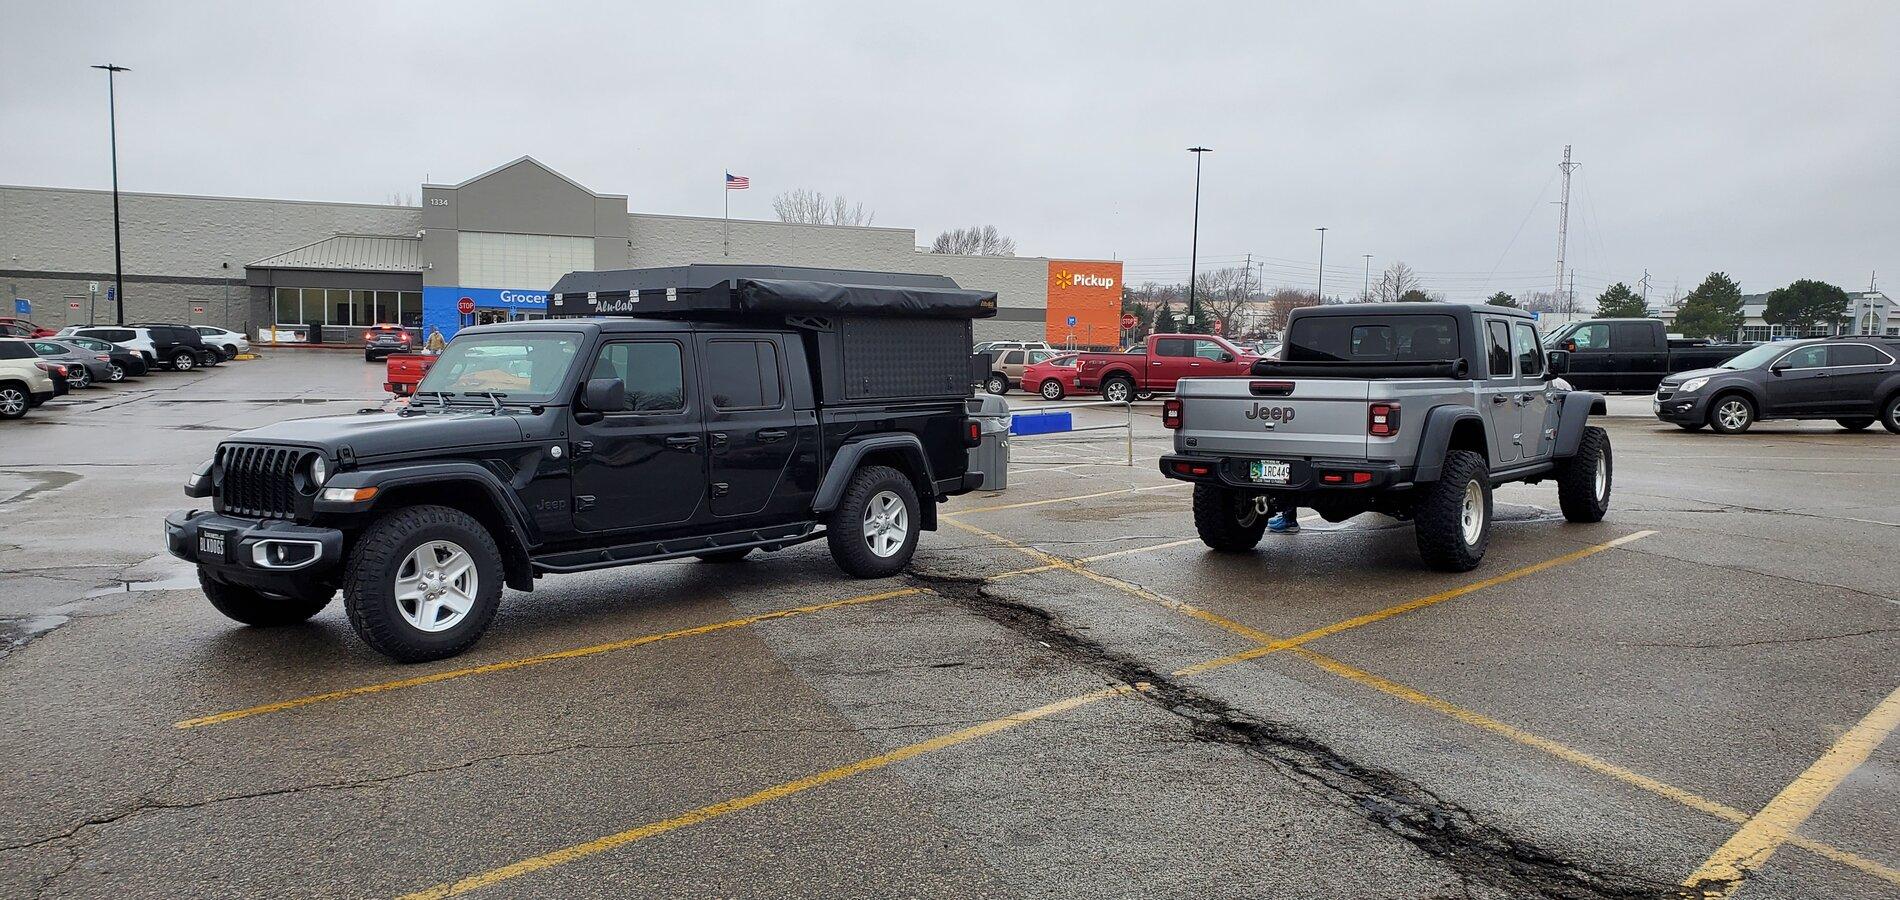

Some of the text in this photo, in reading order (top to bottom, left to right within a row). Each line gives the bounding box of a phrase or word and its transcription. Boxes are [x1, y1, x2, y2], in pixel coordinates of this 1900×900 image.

[430, 198, 449, 206] 1334
[1073, 273, 1114, 290] Pickup
[459, 302, 474, 310] STOP
[595, 299, 633, 313] Alu-Cab
[1122, 318, 1134, 326] STOP
[1245, 402, 1295, 424] Jeep
[536, 499, 566, 511] Jeep
